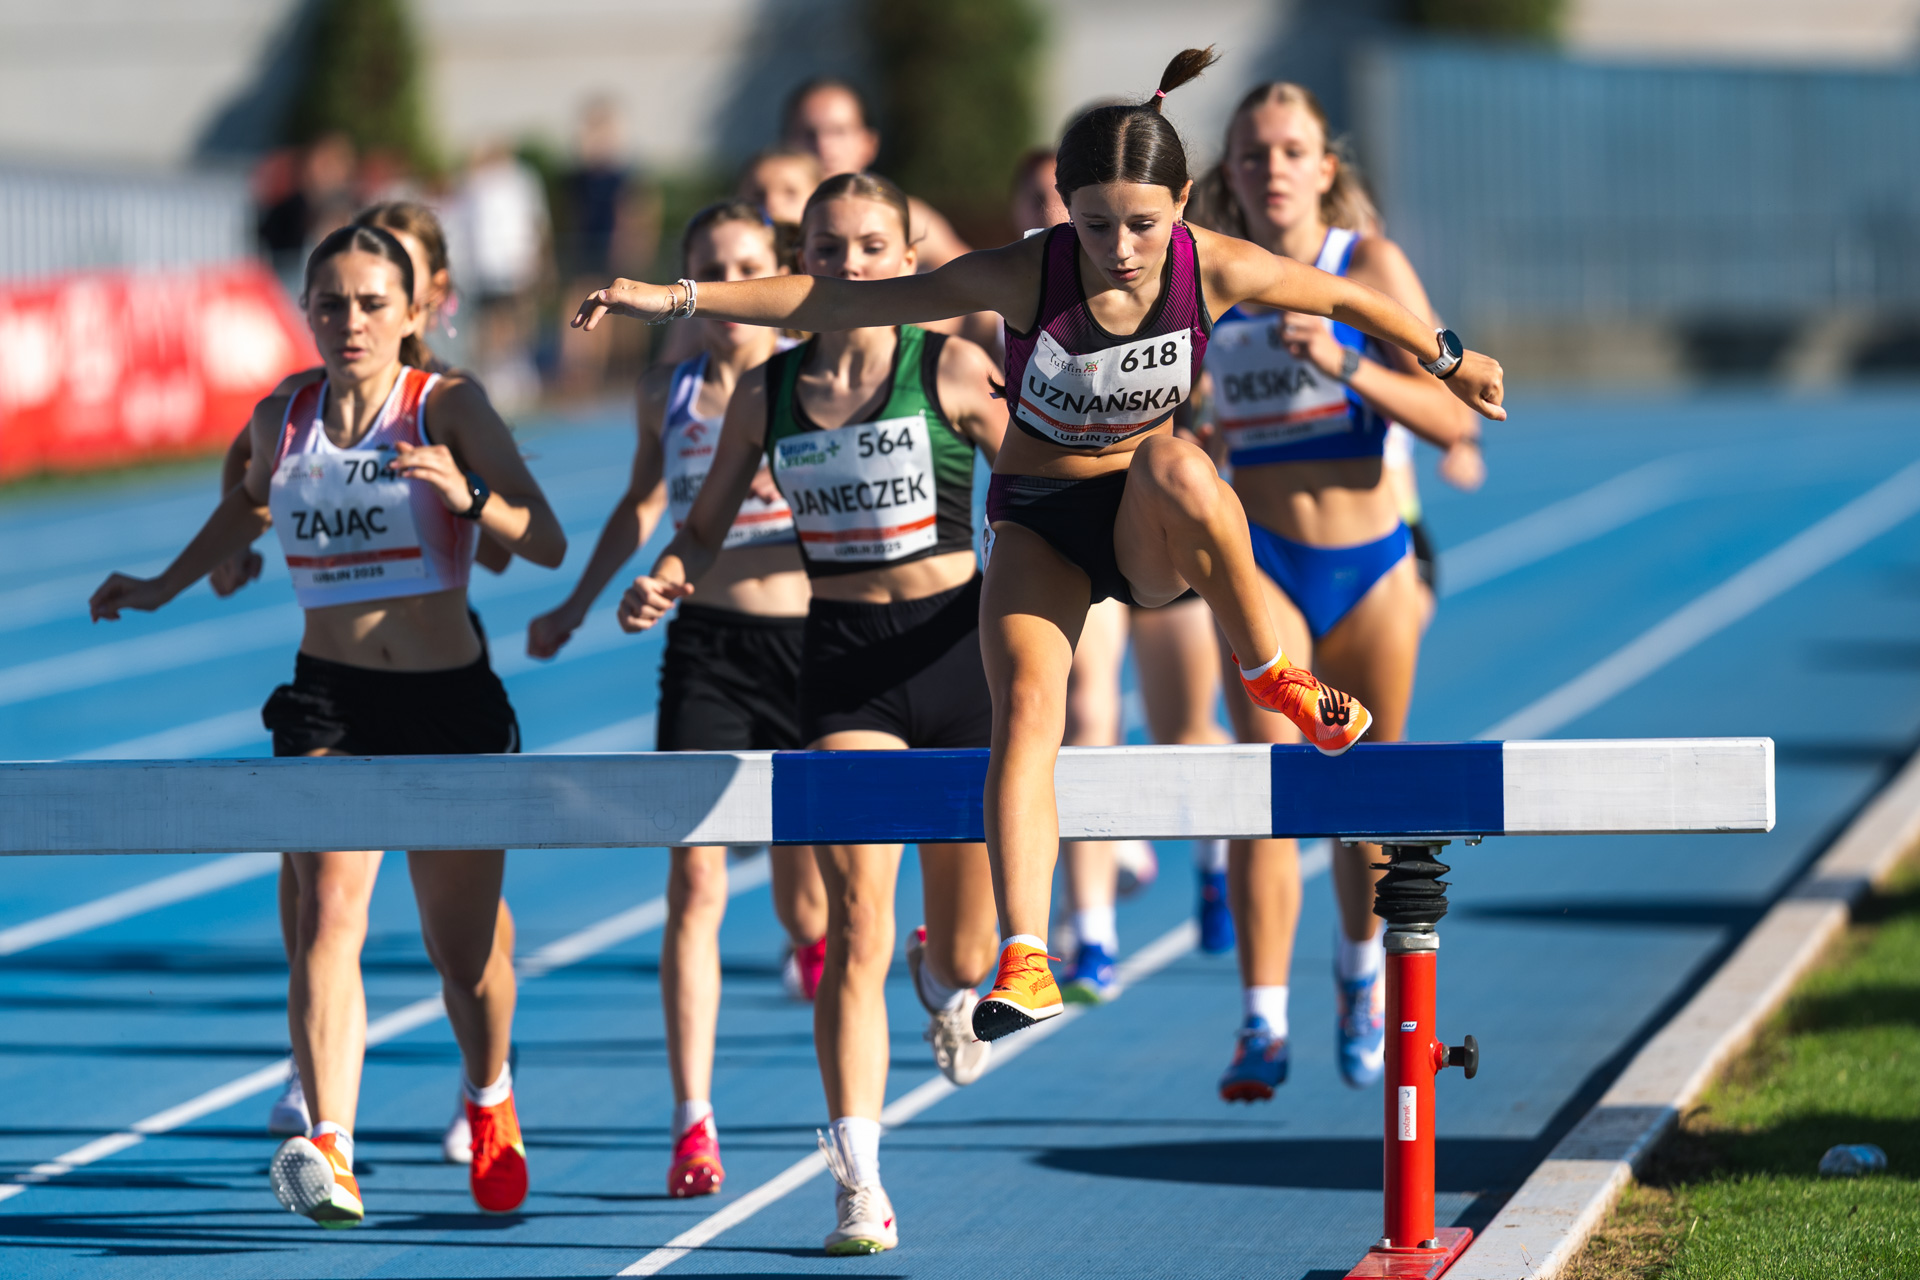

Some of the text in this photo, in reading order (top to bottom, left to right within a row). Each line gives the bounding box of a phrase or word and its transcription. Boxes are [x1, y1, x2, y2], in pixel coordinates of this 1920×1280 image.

[1121, 341, 1178, 373] 618
[1028, 375, 1181, 415] UZNAŃSKA
[1223, 364, 1319, 405] DESKA
[858, 427, 914, 458] 564
[1053, 430, 1101, 443] LUBLIN
[795, 473, 929, 516] JANECZEK
[291, 506, 388, 541] ZAJĄC
[1402, 1104, 1412, 1138] polanik
